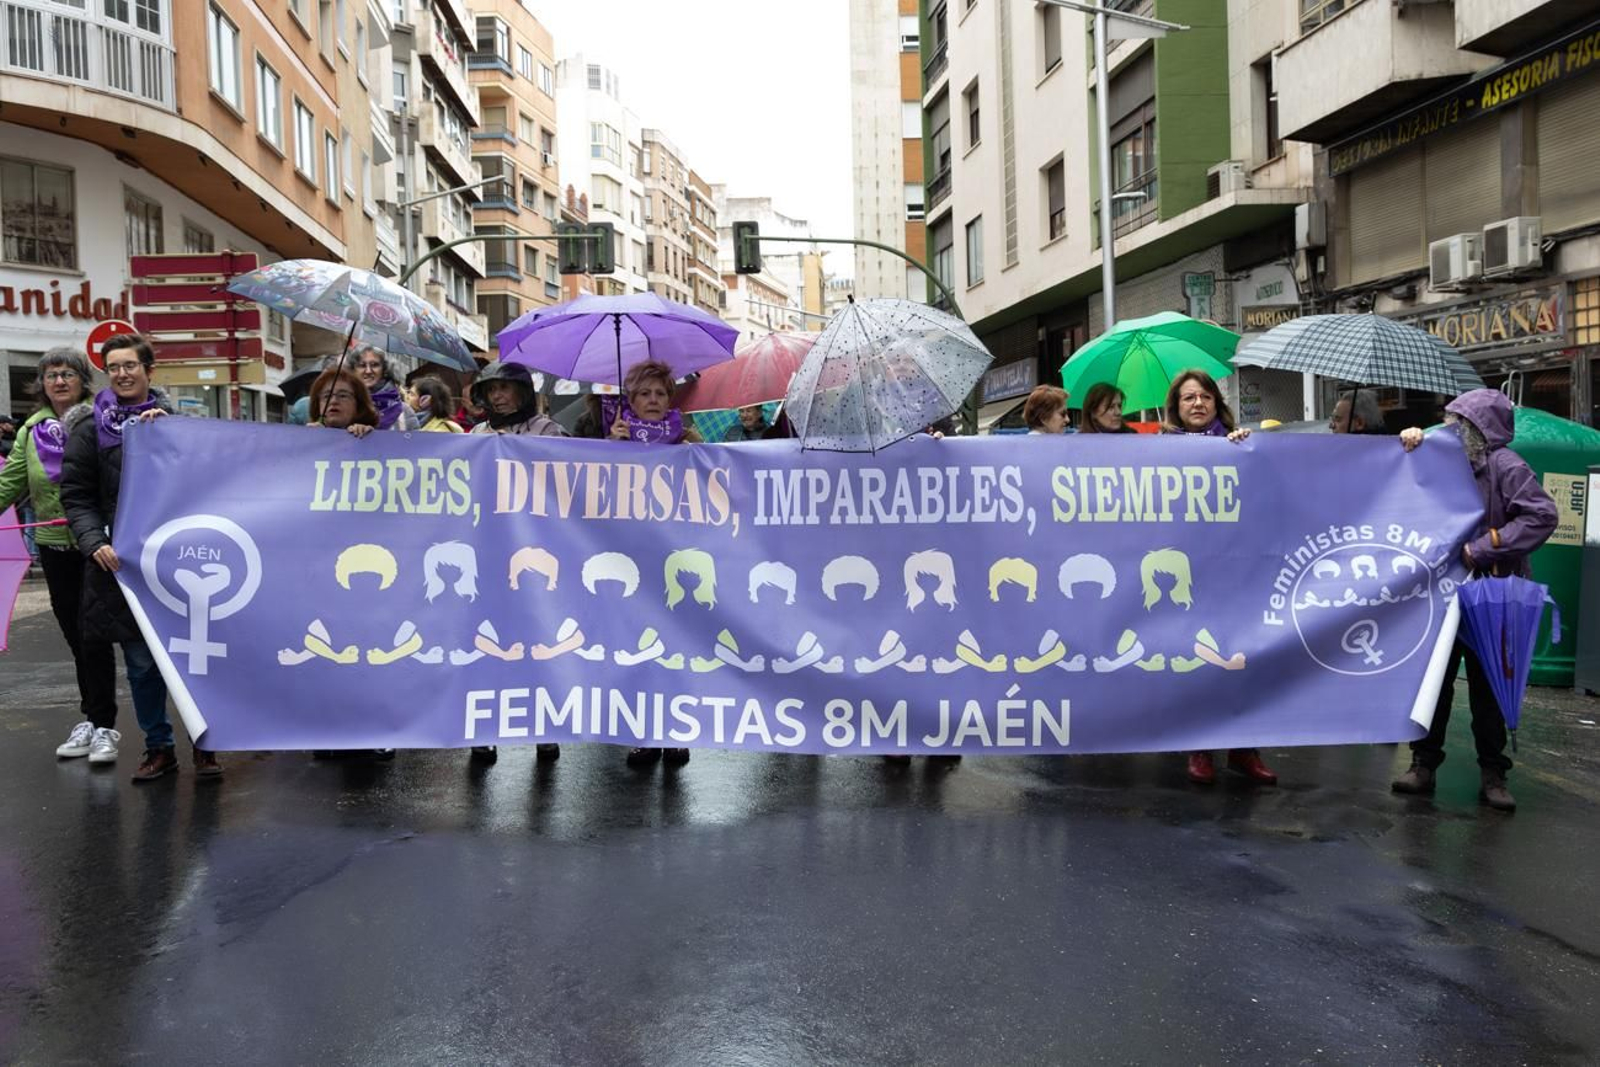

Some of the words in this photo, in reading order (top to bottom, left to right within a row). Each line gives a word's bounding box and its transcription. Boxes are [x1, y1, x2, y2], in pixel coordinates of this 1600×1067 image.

[1481, 50, 1561, 109] ASESORIA
[1427, 300, 1557, 347] MORIANA
[310, 458, 482, 527] LIBRES,
[493, 458, 740, 538] DIVERSAS,
[753, 465, 1037, 536] IMPARABLES,
[1051, 465, 1241, 523] SIEMPRE
[177, 545, 221, 561] JAÉN
[1263, 524, 1375, 626] Feministas
[1386, 523, 1432, 554] 8M
[464, 686, 806, 747] FEMINISTAS
[822, 698, 908, 748] 8M
[922, 683, 1072, 748] JAÉN
